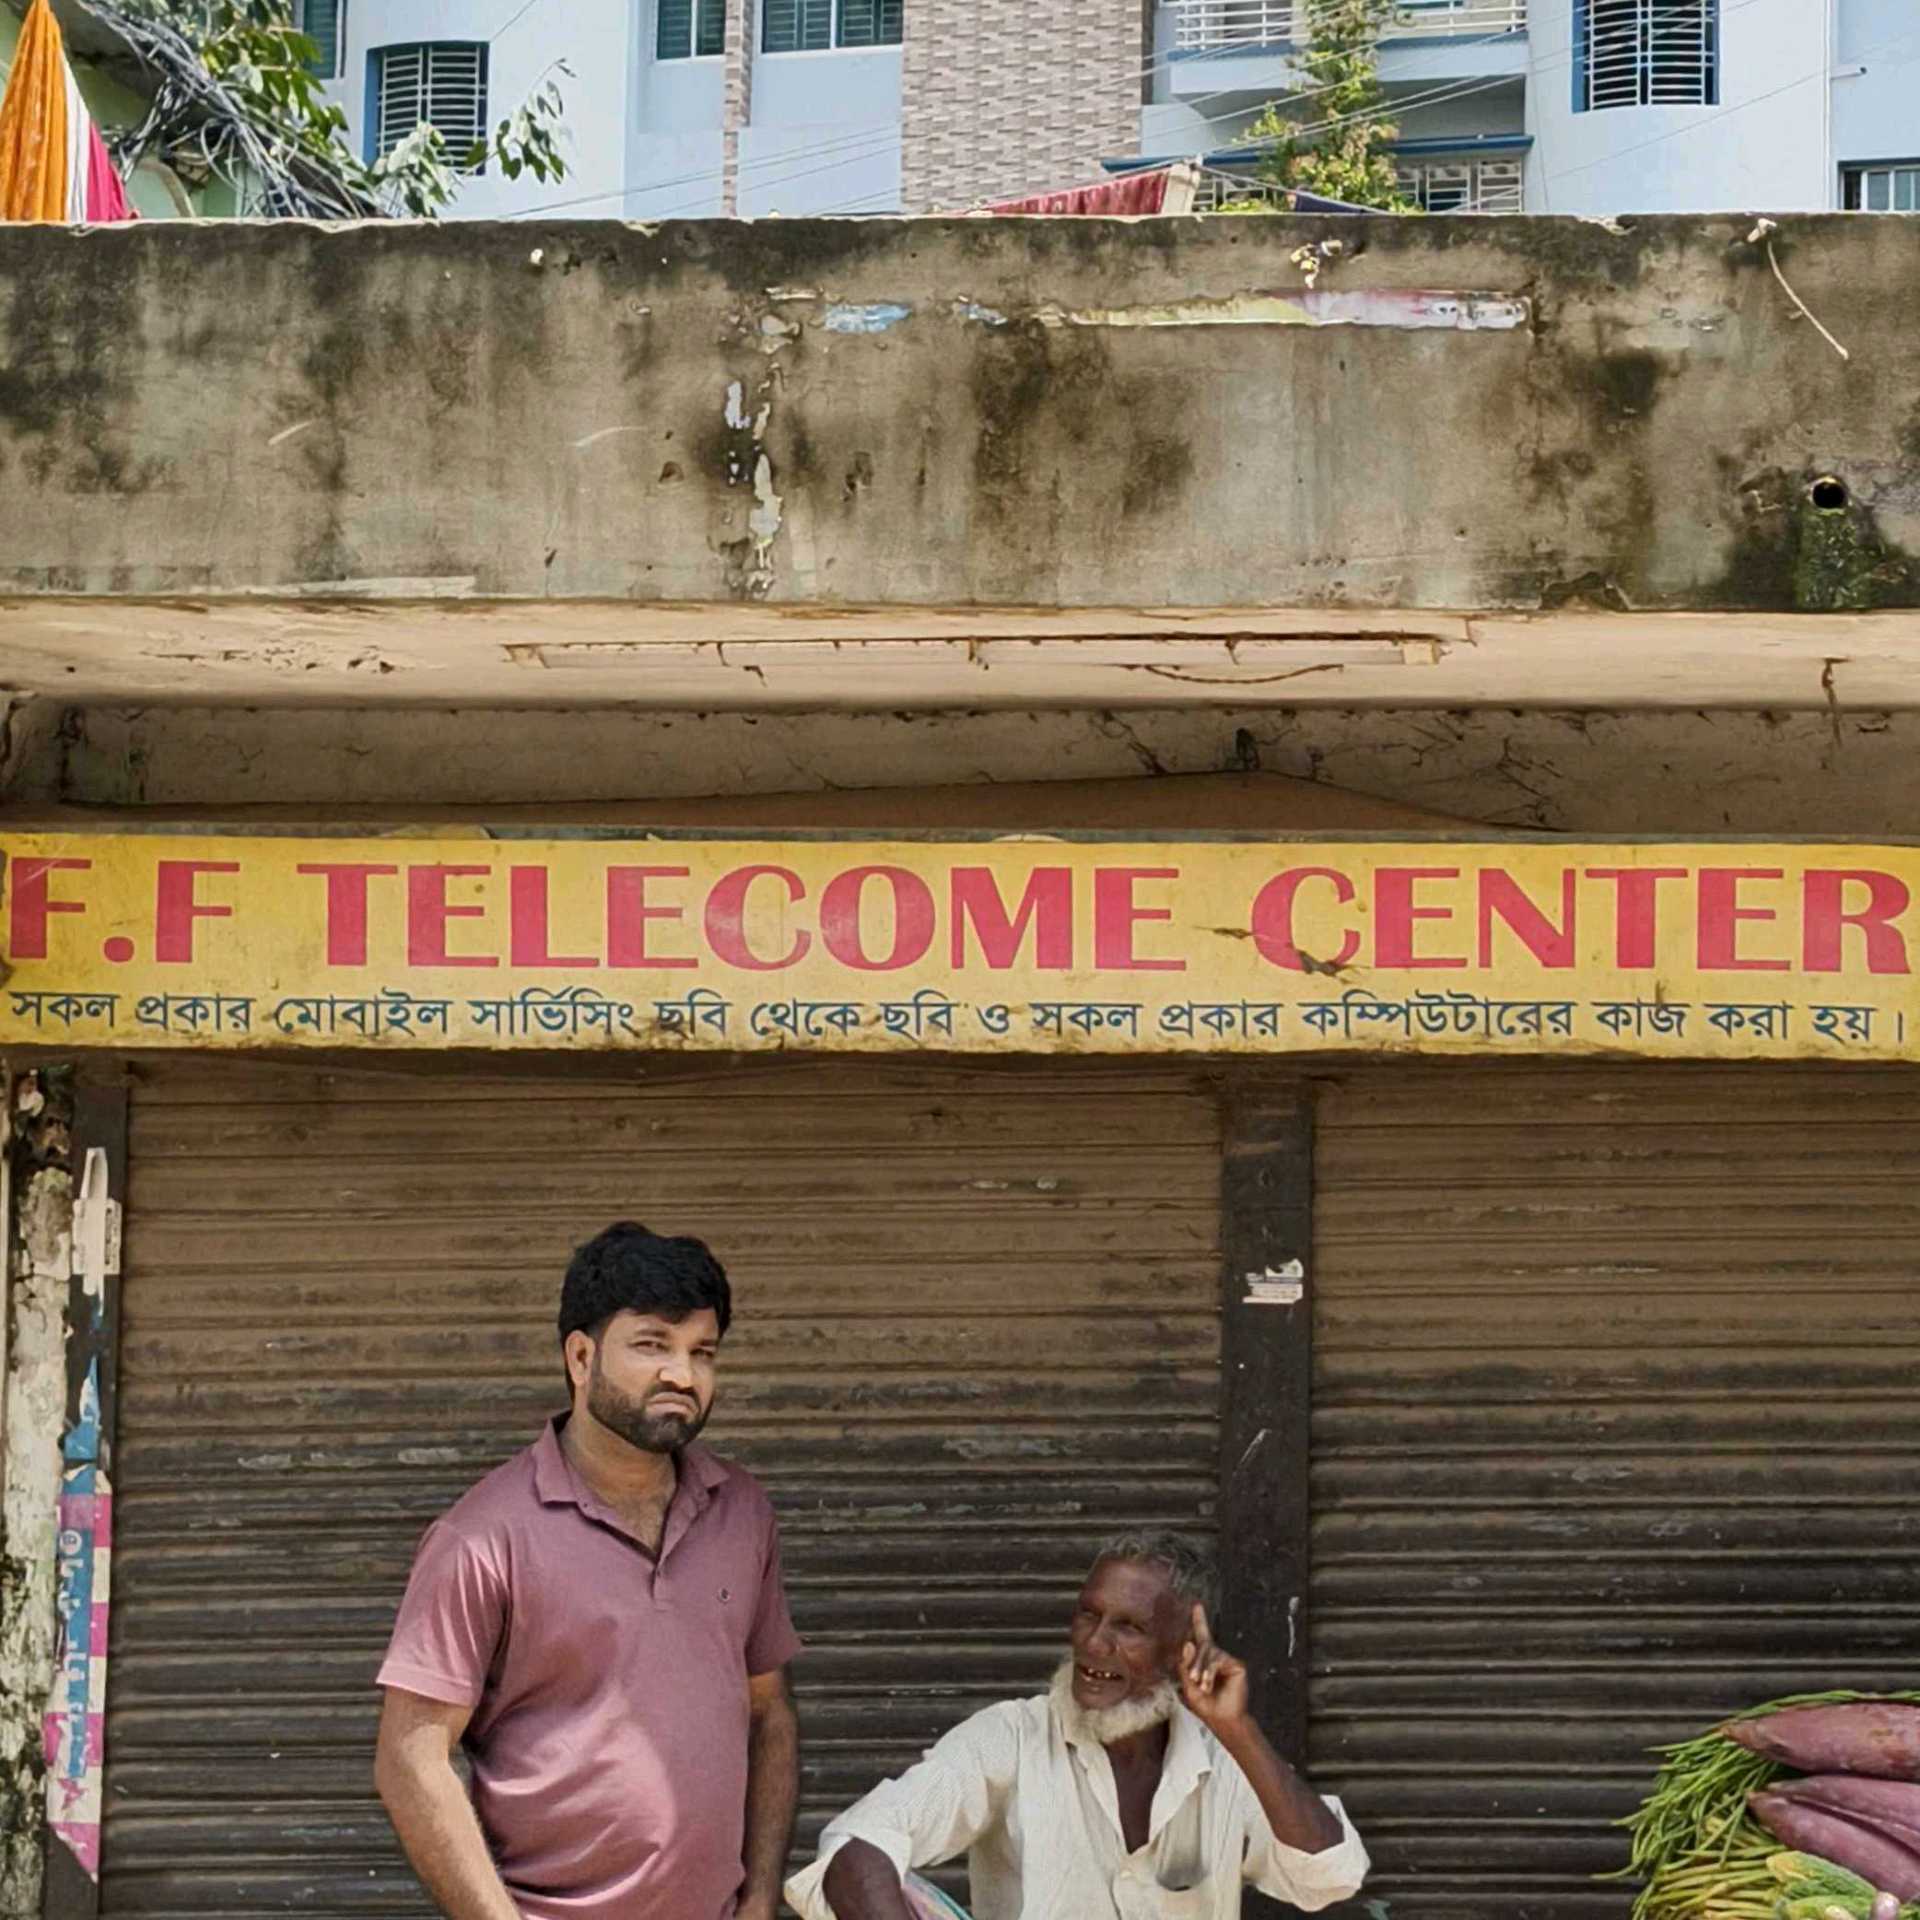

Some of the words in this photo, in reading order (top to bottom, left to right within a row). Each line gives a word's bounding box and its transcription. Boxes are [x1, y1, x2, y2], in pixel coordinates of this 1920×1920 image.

[9, 857, 241, 964] F.F
[296, 863, 1187, 971] TELECOME
[1250, 867, 1912, 974] CENTER
[8, 991, 120, 1029] সকল
[135, 993, 257, 1036] প্রকার
[273, 986, 452, 1036] মোবাইল
[468, 985, 635, 1037] সার্ভিসিং
[652, 988, 733, 1040] ছবি
[749, 997, 864, 1040] থেকে
[878, 989, 960, 1038] ছবি
[976, 1001, 1013, 1036] ও
[1029, 1002, 1143, 1038] সকল
[1157, 1000, 1285, 1038] প্রকার
[1298, 988, 1578, 1037] কম্পিউটারের
[1590, 997, 1691, 1039] কাজ
[1704, 1001, 1796, 1041] করা
